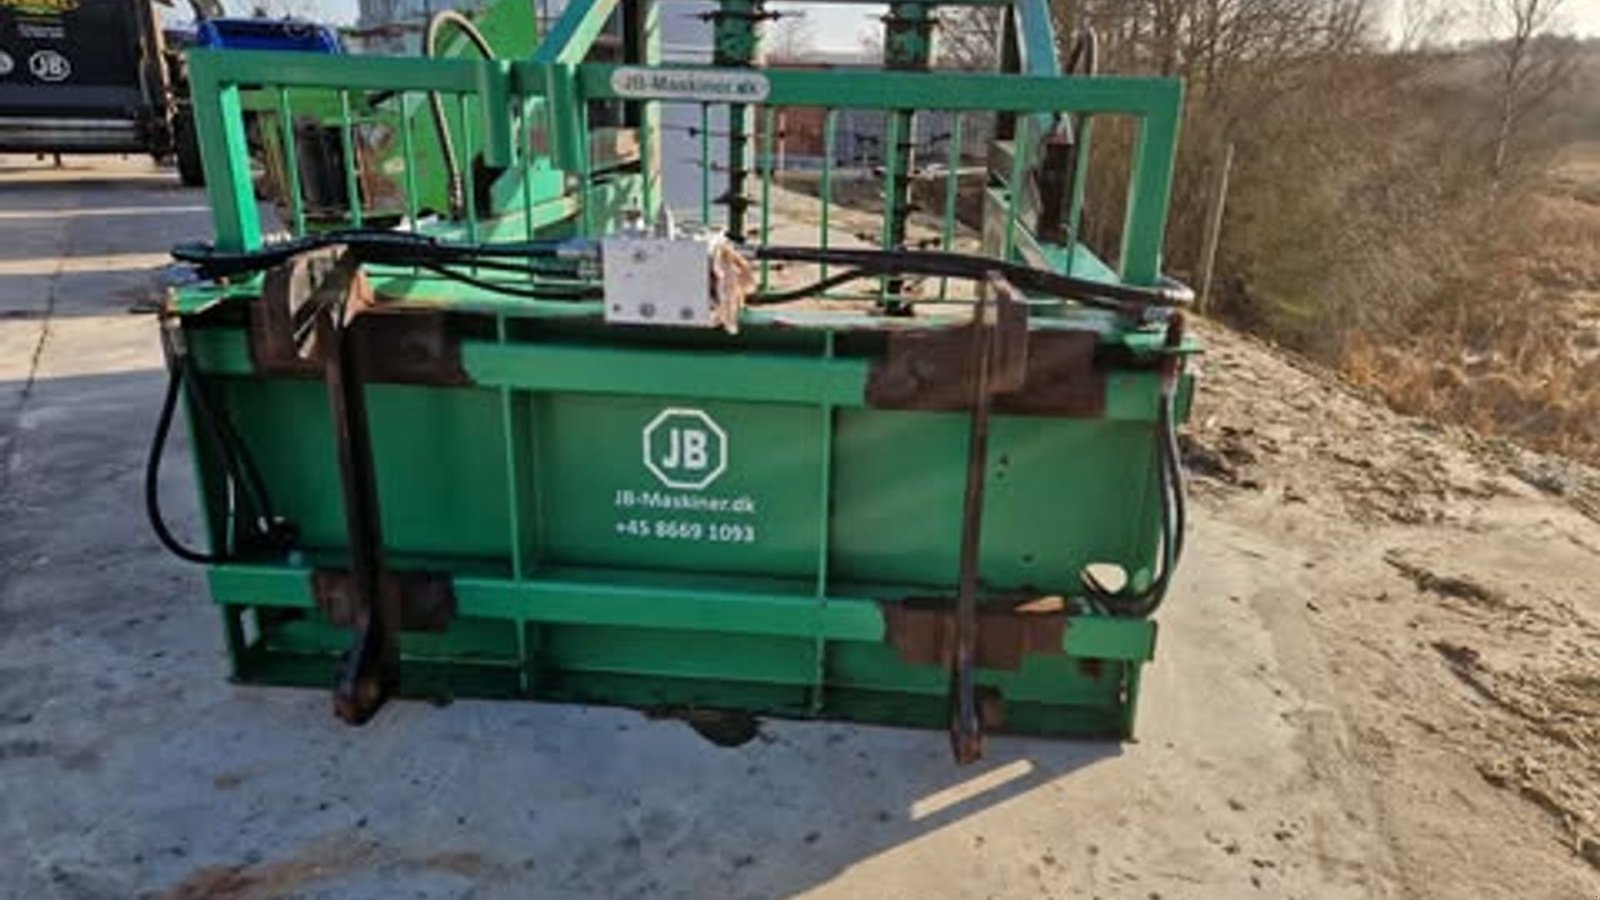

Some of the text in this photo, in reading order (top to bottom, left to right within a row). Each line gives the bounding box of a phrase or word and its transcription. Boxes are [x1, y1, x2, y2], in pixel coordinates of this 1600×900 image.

[662, 427, 708, 469] JB
[615, 490, 756, 514] JB-Maskiner.dk
[615, 519, 756, 543] +45 8669 1093
